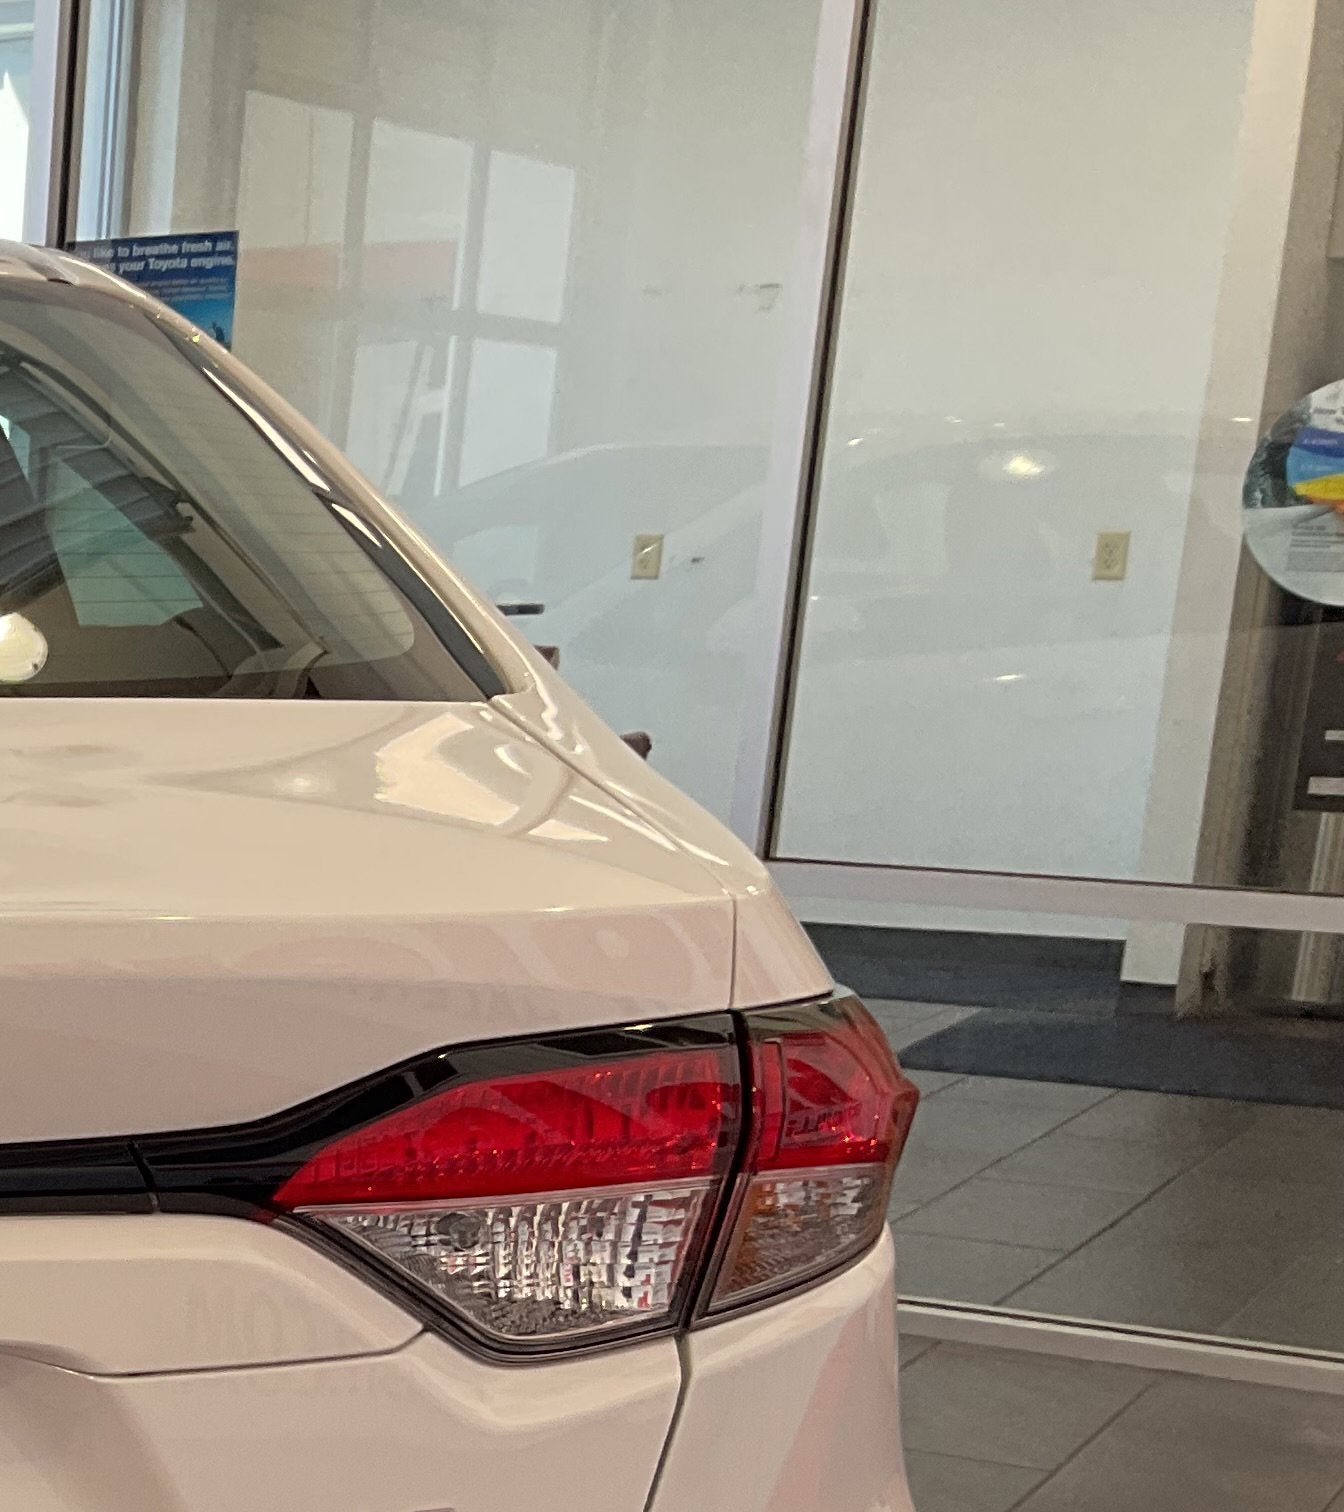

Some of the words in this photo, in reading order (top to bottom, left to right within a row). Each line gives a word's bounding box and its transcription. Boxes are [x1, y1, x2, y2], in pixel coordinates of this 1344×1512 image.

[118, 246, 129, 257] to
[132, 242, 178, 256] breathe
[182, 240, 212, 253] fresh
[119, 260, 145, 274] your
[148, 257, 188, 272] Toyota
